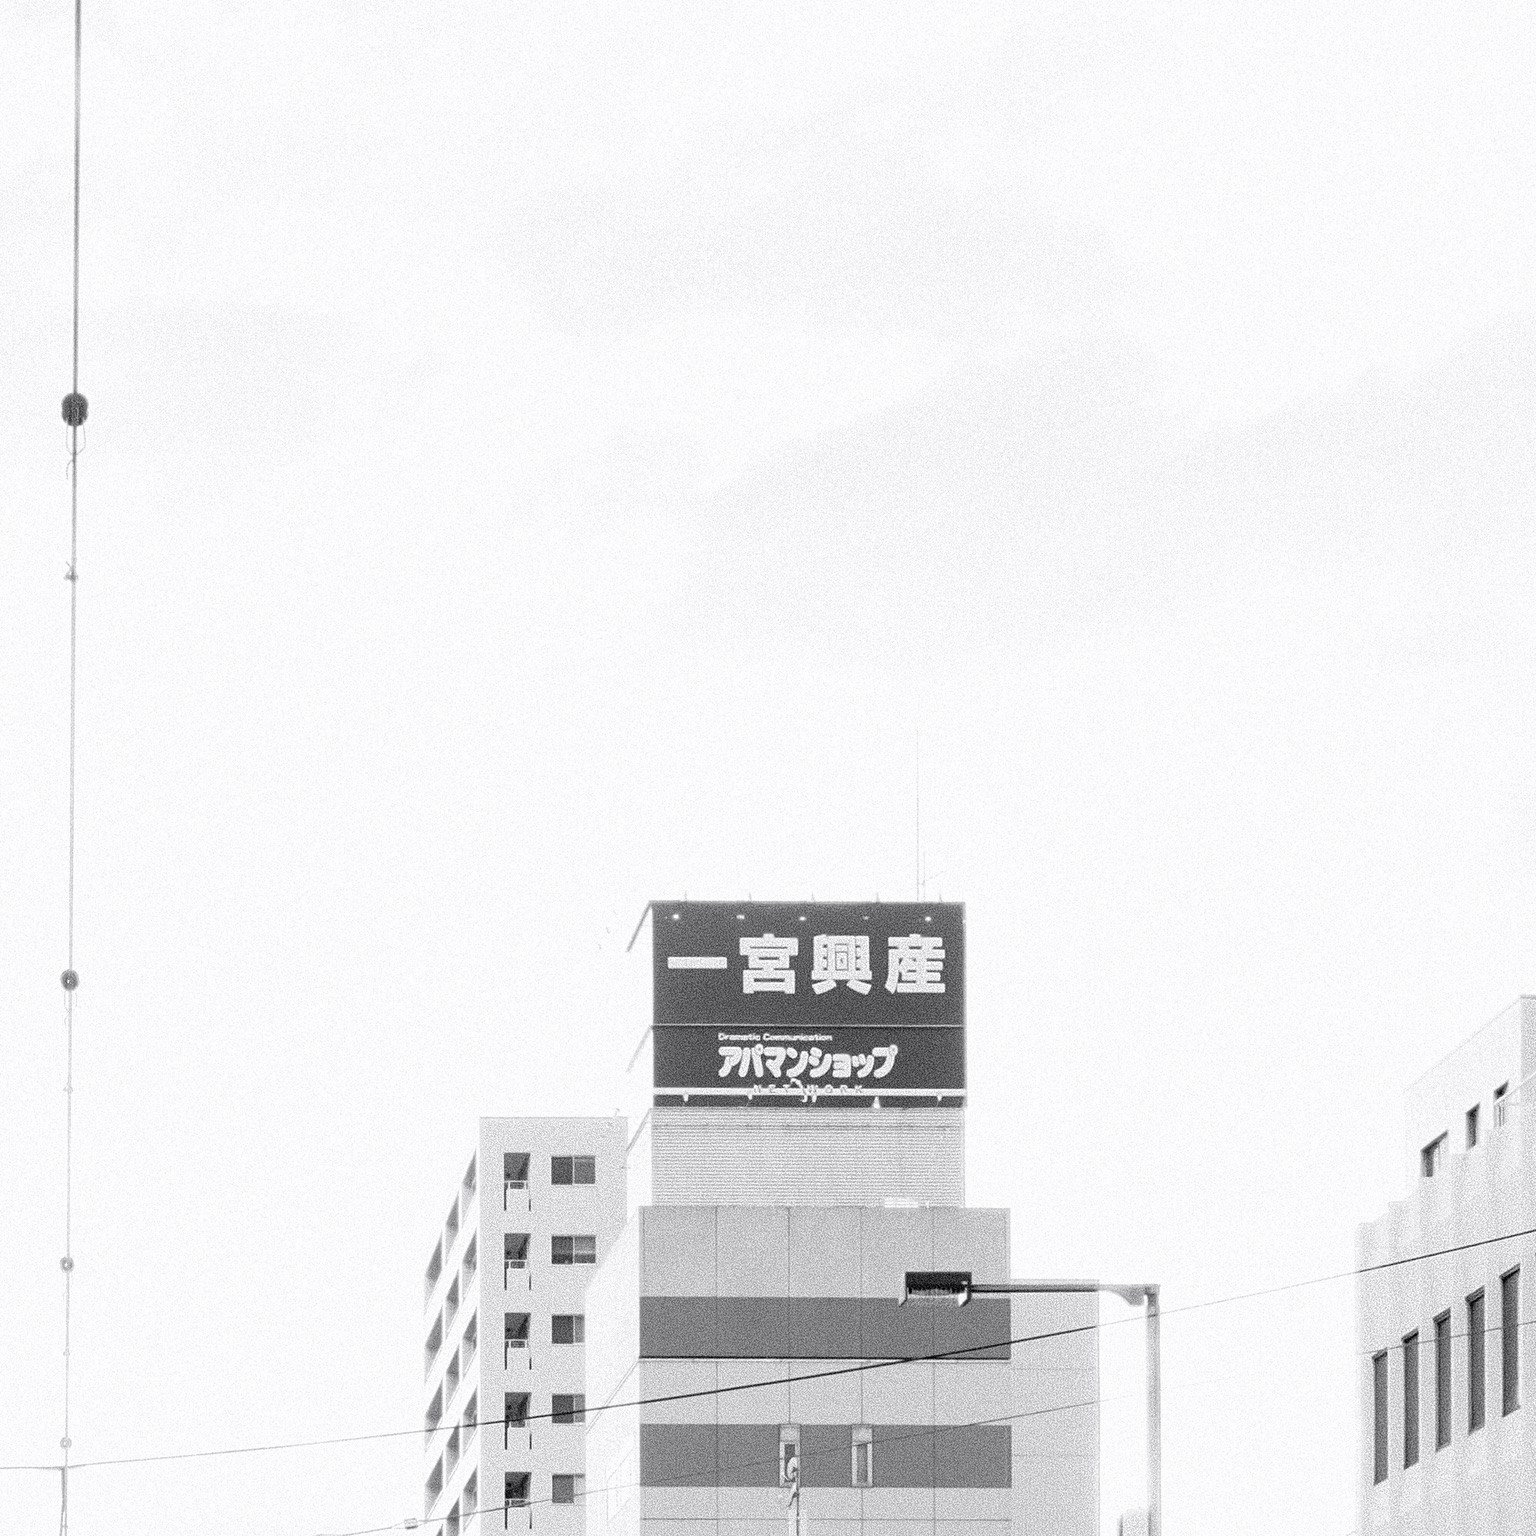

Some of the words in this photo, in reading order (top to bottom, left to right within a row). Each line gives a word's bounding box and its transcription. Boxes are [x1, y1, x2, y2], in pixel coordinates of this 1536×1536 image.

[667, 933, 946, 995] 一宮興産
[718, 1044, 898, 1078] アパマンショップ
